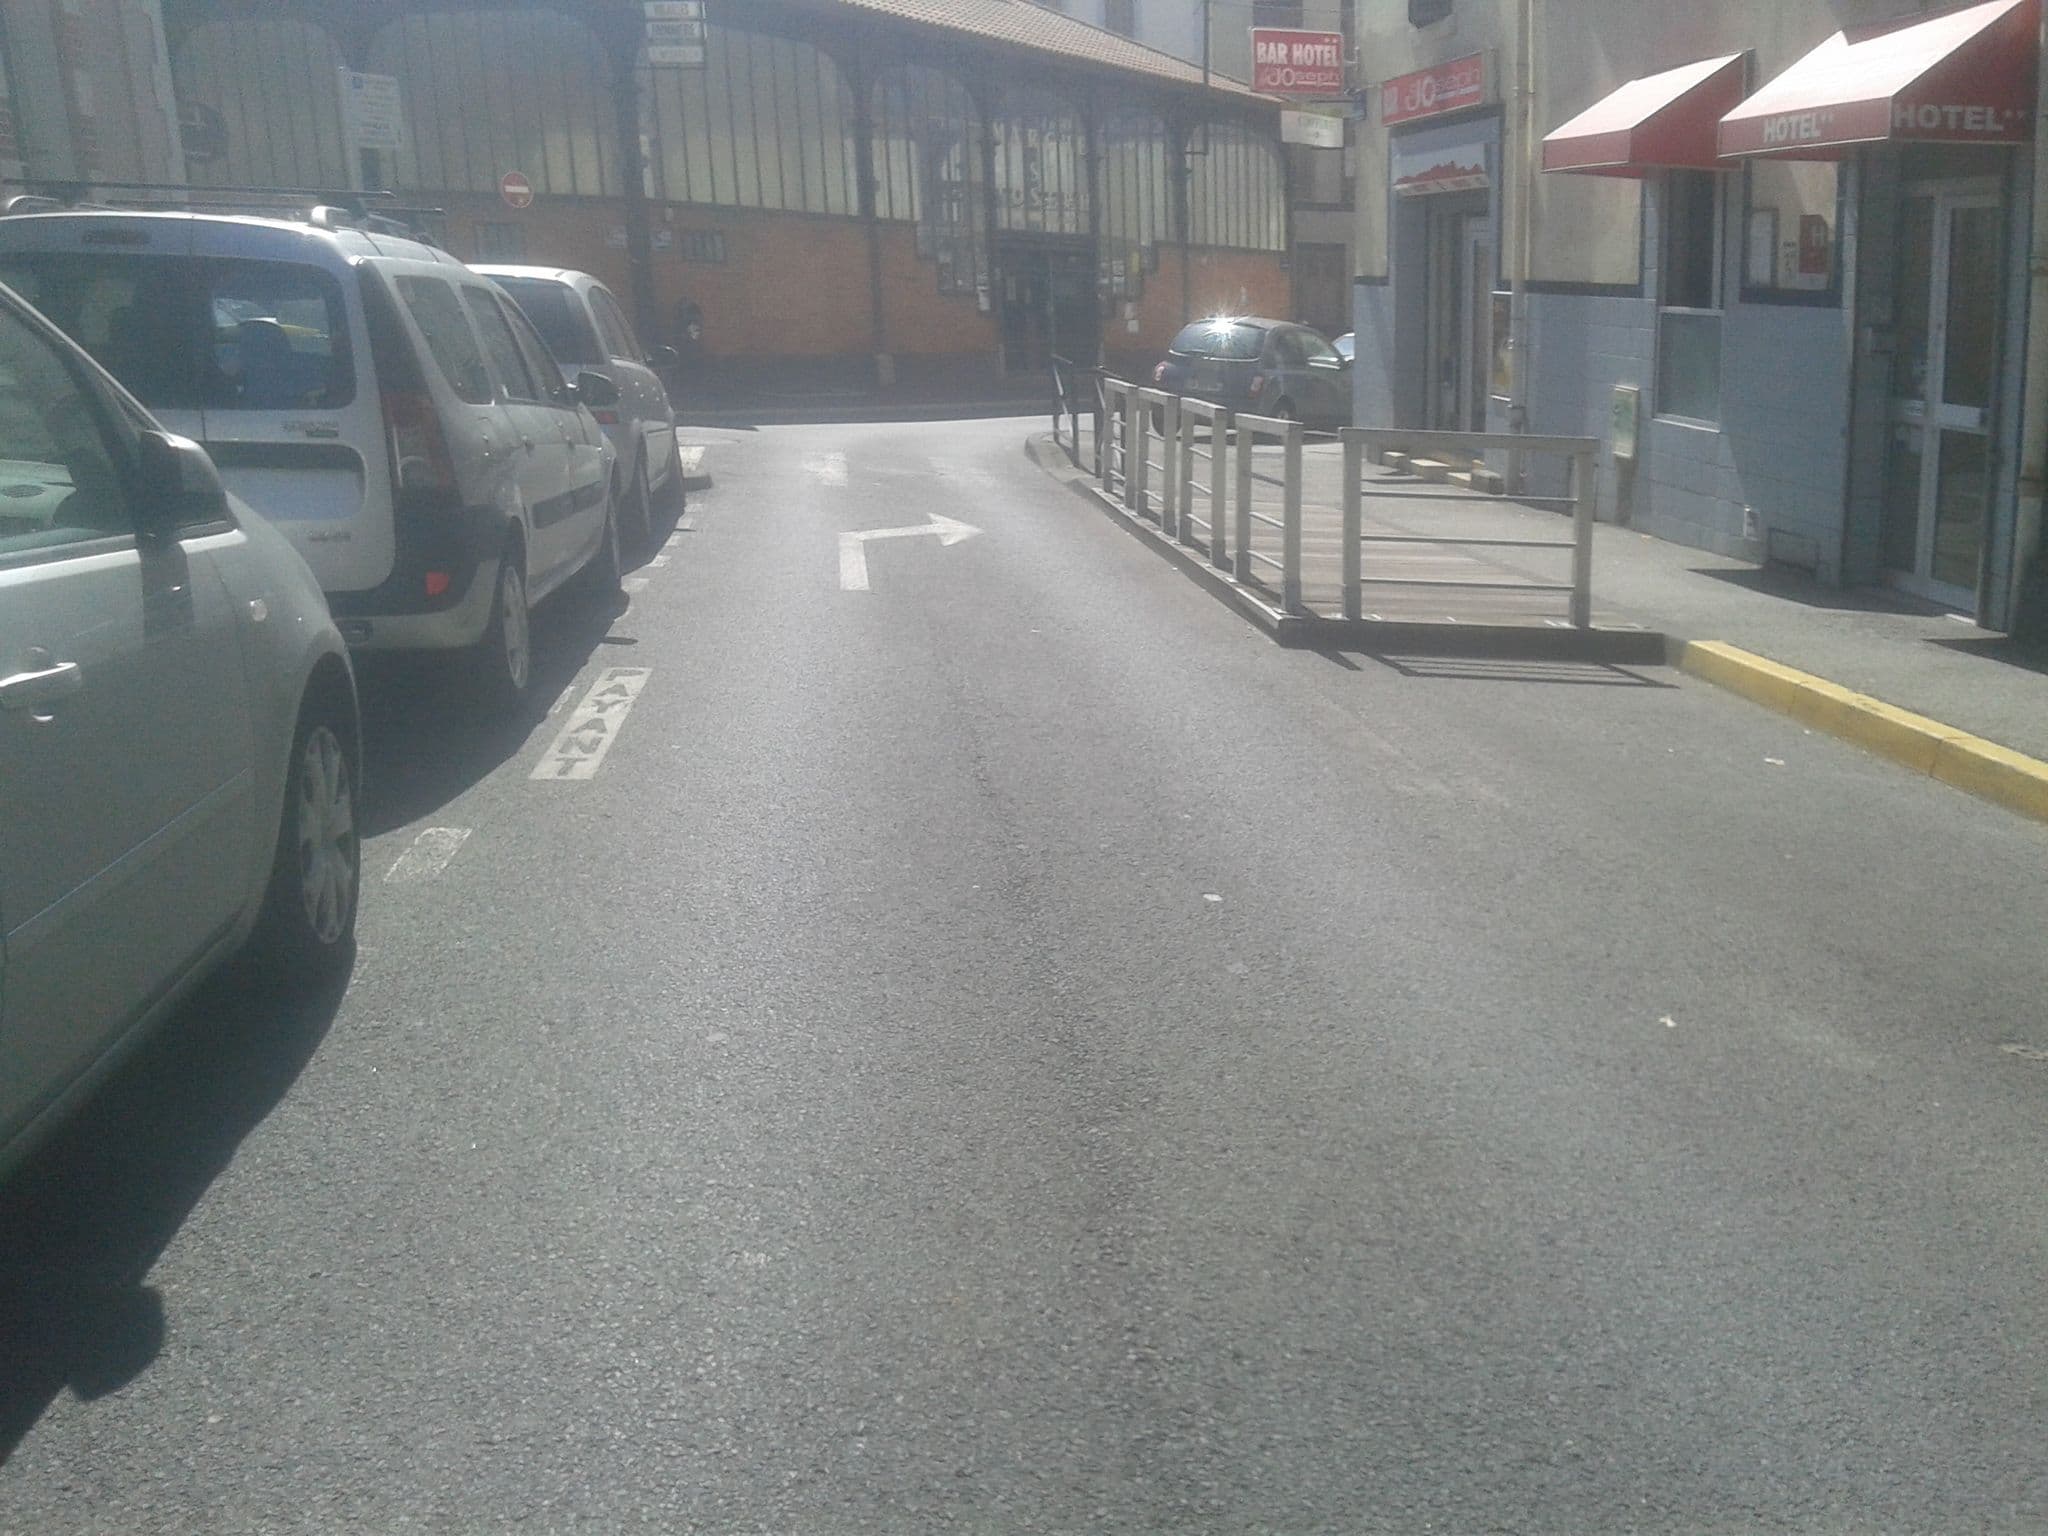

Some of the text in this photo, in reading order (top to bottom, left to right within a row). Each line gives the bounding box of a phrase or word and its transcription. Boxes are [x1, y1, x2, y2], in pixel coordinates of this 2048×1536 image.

[1256, 41, 1338, 67] BAR HOTEL
[1764, 111, 1822, 143] HOTEL
[1892, 103, 2004, 131] HOTEL
[554, 668, 646, 776] PAYANT
